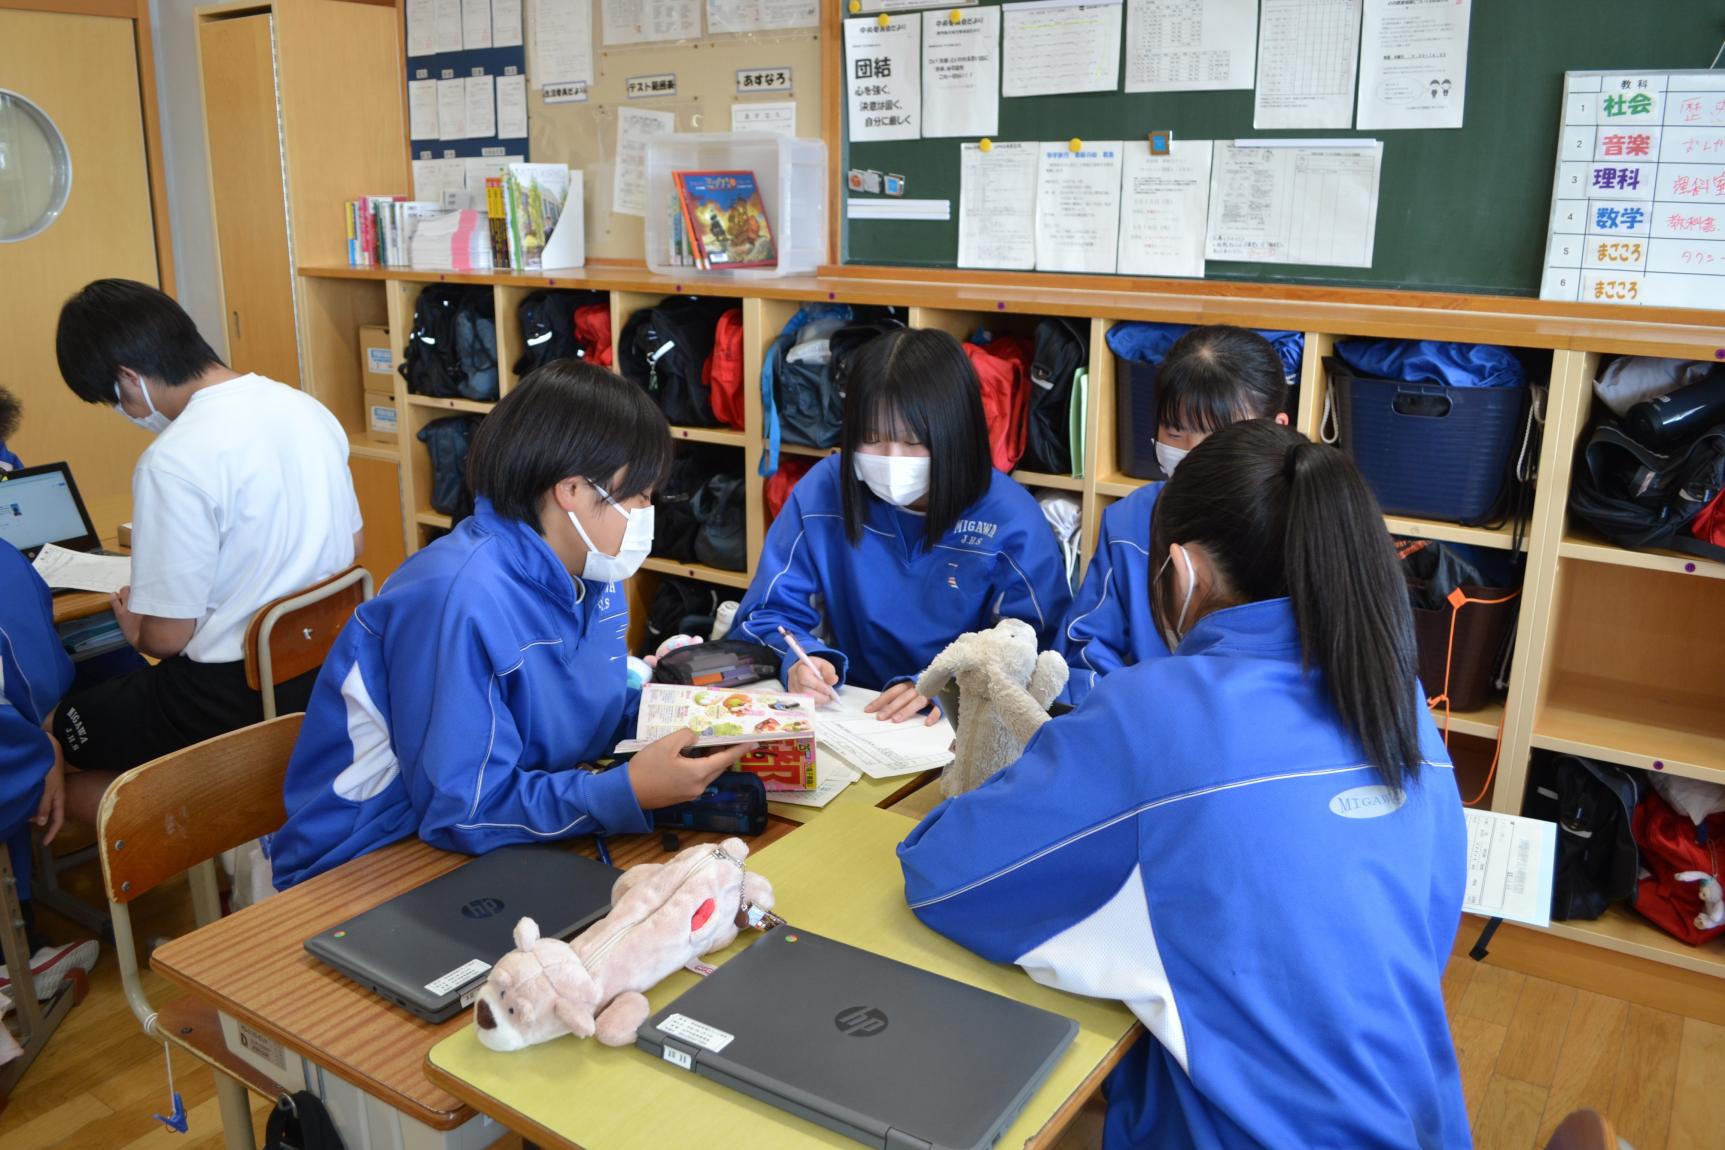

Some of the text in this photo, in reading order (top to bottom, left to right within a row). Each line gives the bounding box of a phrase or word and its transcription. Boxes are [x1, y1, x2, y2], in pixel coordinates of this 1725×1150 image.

[854, 57, 891, 79] 団結
[743, 72, 786, 87] あすなろ
[1620, 79, 1649, 90] 教科
[1603, 93, 1653, 117] 社会
[1576, 140, 1583, 149] 2
[1602, 134, 1651, 157] 音楽
[1571, 175, 1578, 184] 3
[1592, 168, 1641, 190] 理科
[1566, 212, 1573, 221] 4
[1596, 207, 1644, 229] 数学
[1562, 247, 1569, 256] 5
[1559, 278, 1566, 287] 6
[953, 519, 998, 538] MIGAWA
[66, 706, 89, 744] MIGAWA
[461, 897, 505, 919] hp
